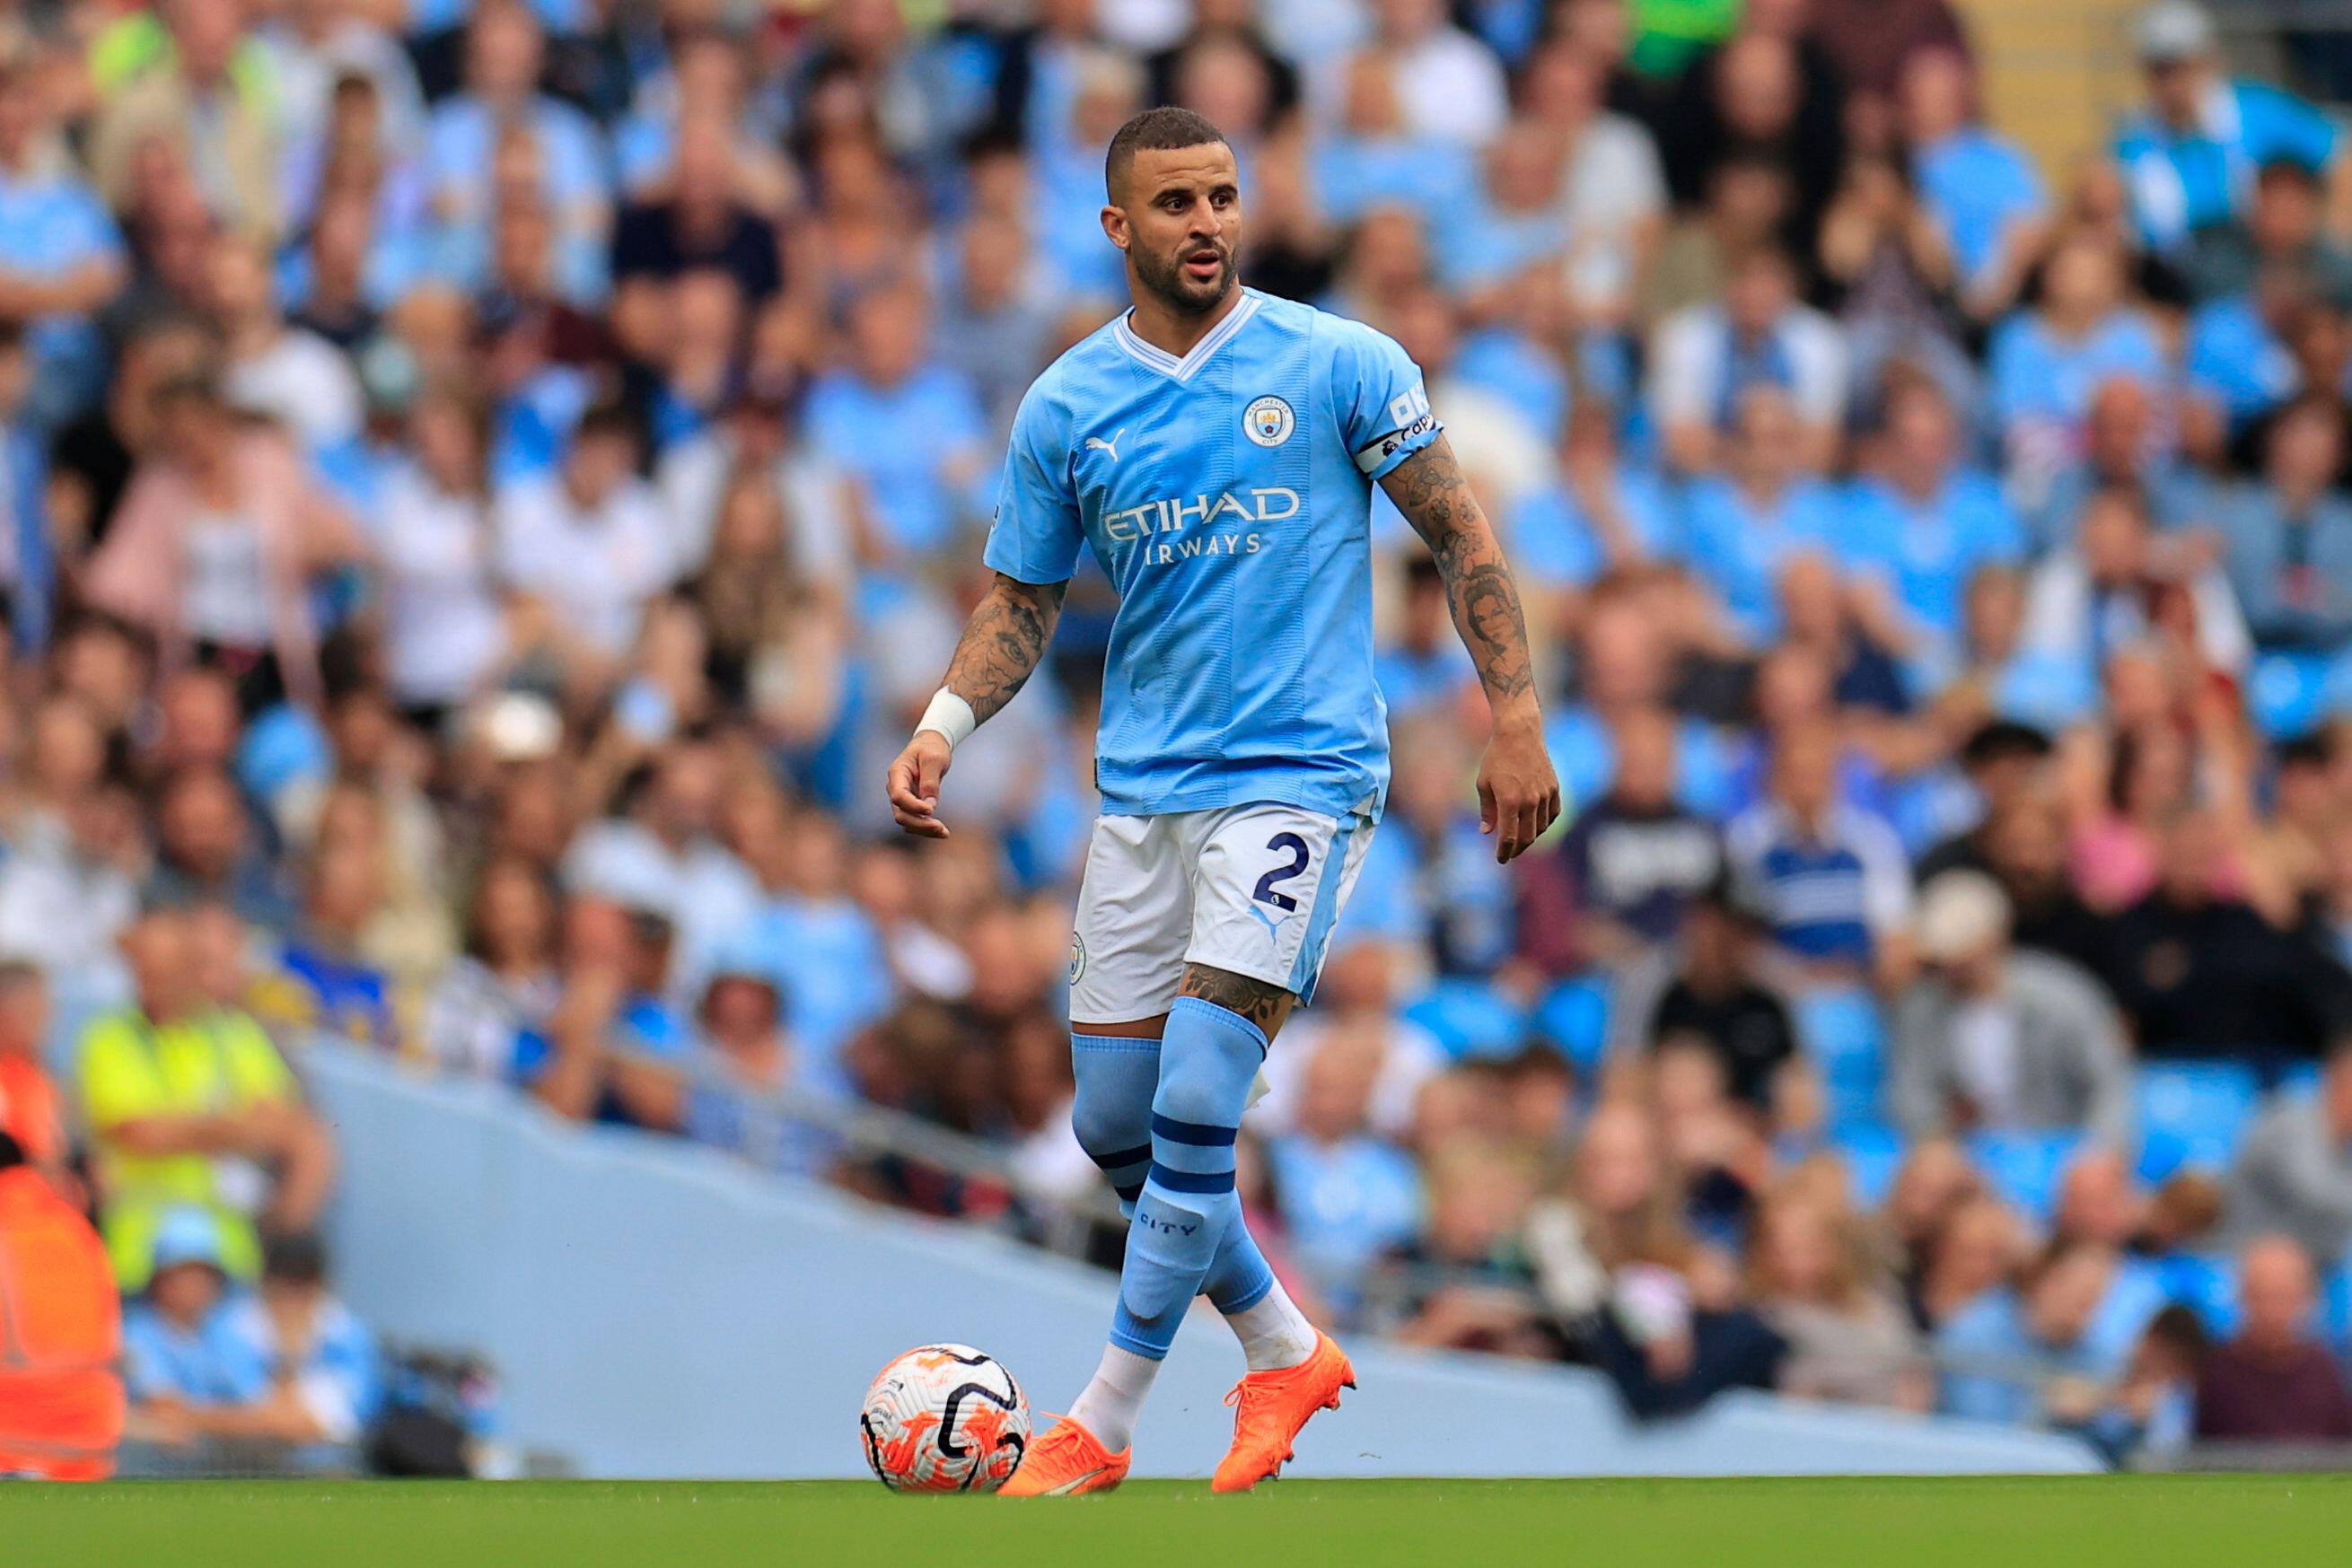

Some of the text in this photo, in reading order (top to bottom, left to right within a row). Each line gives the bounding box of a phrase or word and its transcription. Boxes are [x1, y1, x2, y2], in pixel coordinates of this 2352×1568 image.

[1248, 399, 1289, 416] MANCHESTER
[1401, 414, 1431, 442] Cap
[1105, 487, 1300, 540] ETIHAD
[1145, 533, 1260, 566] IRWAYS
[1252, 832, 1310, 913] 2
[1140, 1213, 1197, 1236] CITY
